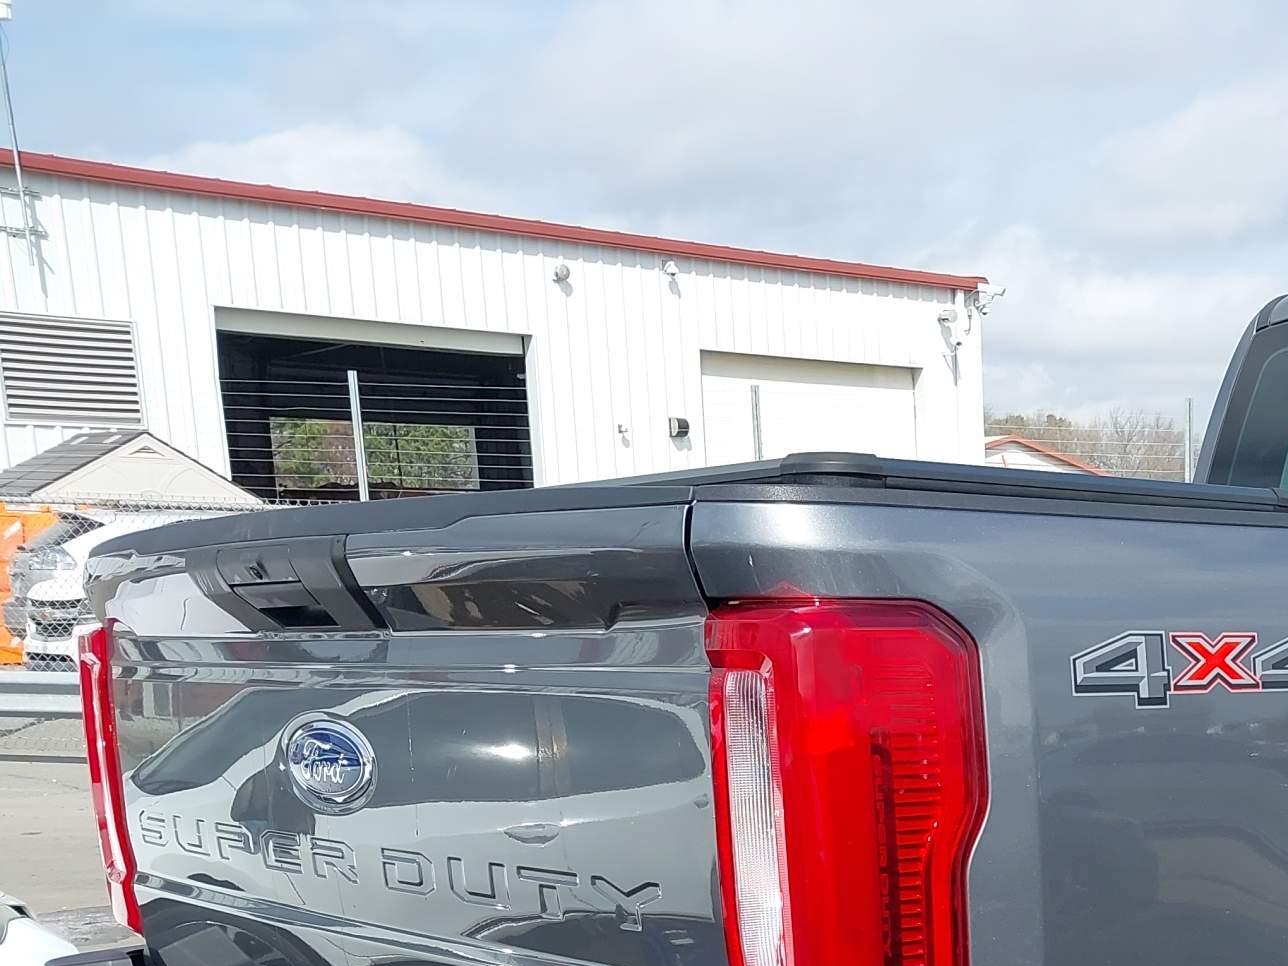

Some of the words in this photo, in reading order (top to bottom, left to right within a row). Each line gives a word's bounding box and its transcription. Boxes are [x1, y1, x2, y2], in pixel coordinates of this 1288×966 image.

[301, 738, 348, 784] Ford
[138, 809, 360, 885] SUPER
[380, 847, 663, 932] DUTY
